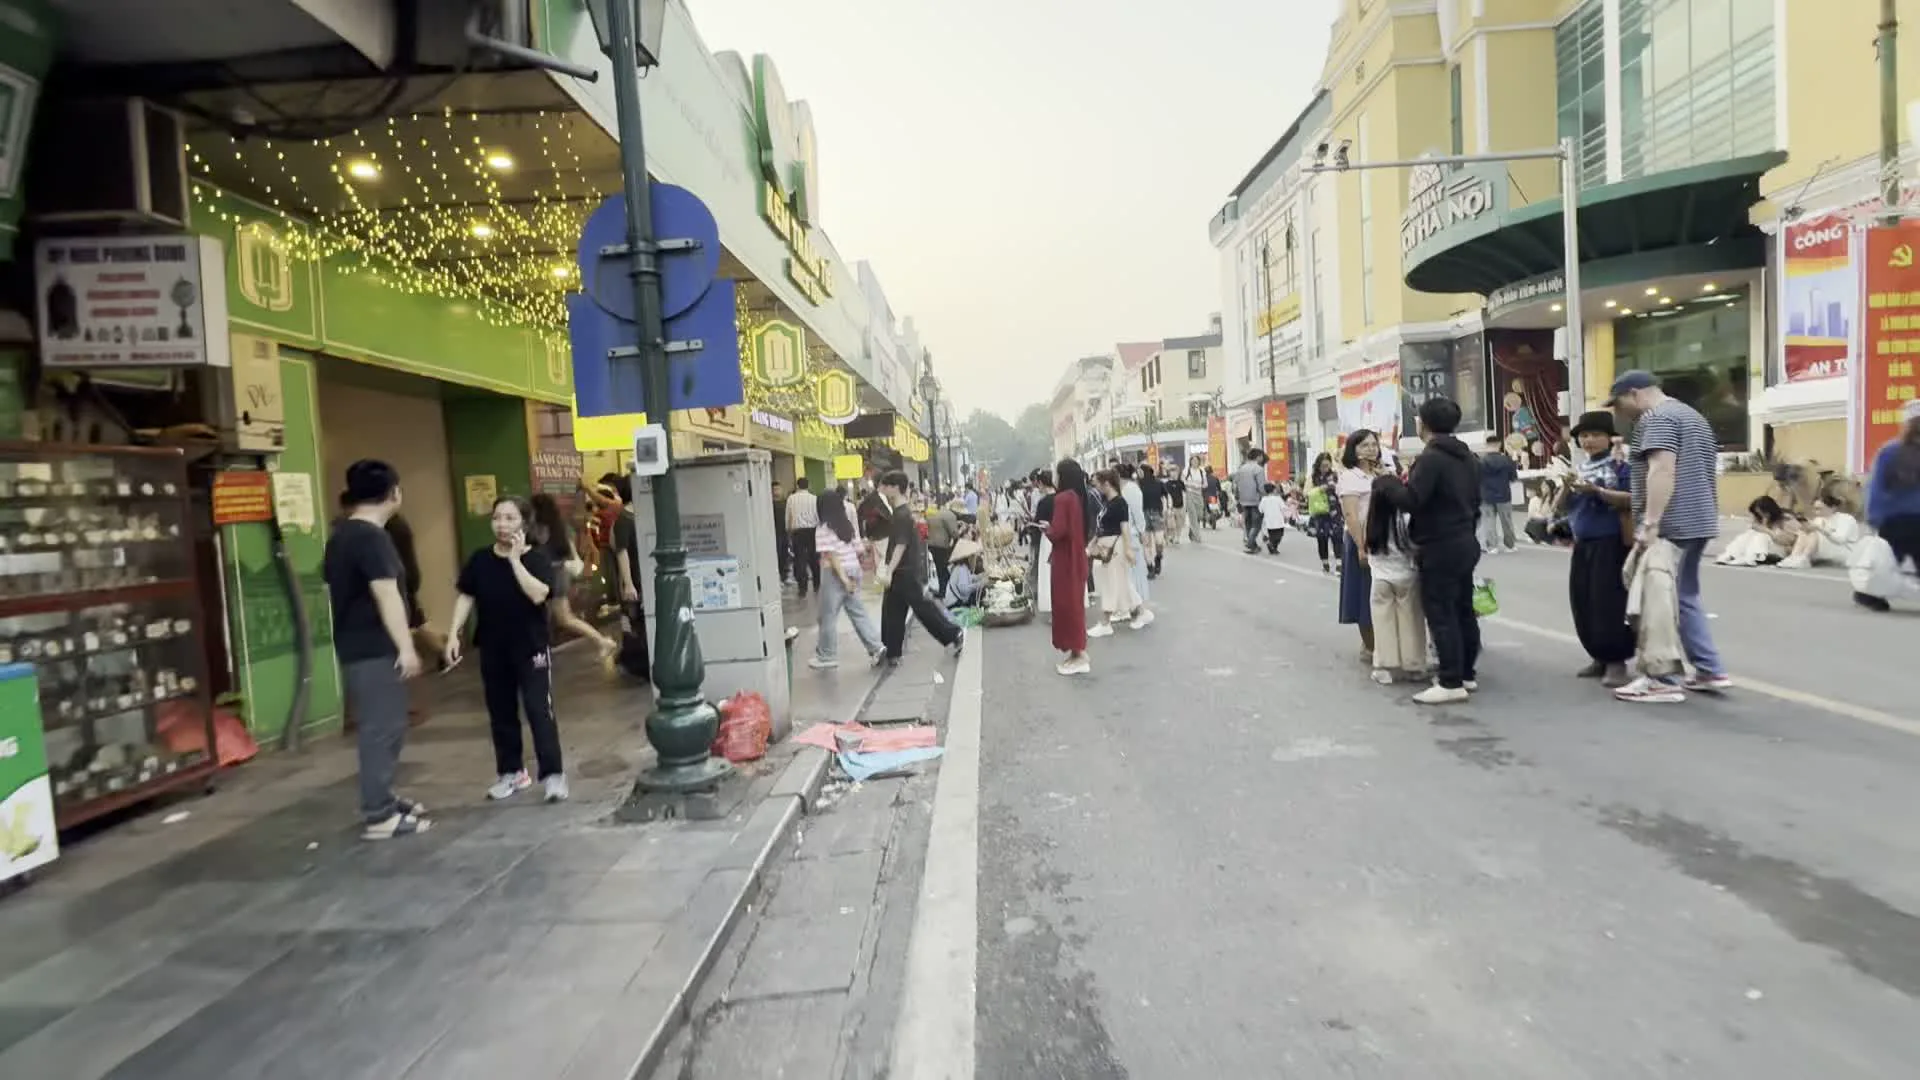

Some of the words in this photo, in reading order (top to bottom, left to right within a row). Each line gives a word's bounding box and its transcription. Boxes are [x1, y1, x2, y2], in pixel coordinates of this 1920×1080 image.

[1449, 180, 1494, 225] NỘI
[1794, 226, 1842, 250] CÔNG
[1808, 359, 1831, 376] AN
